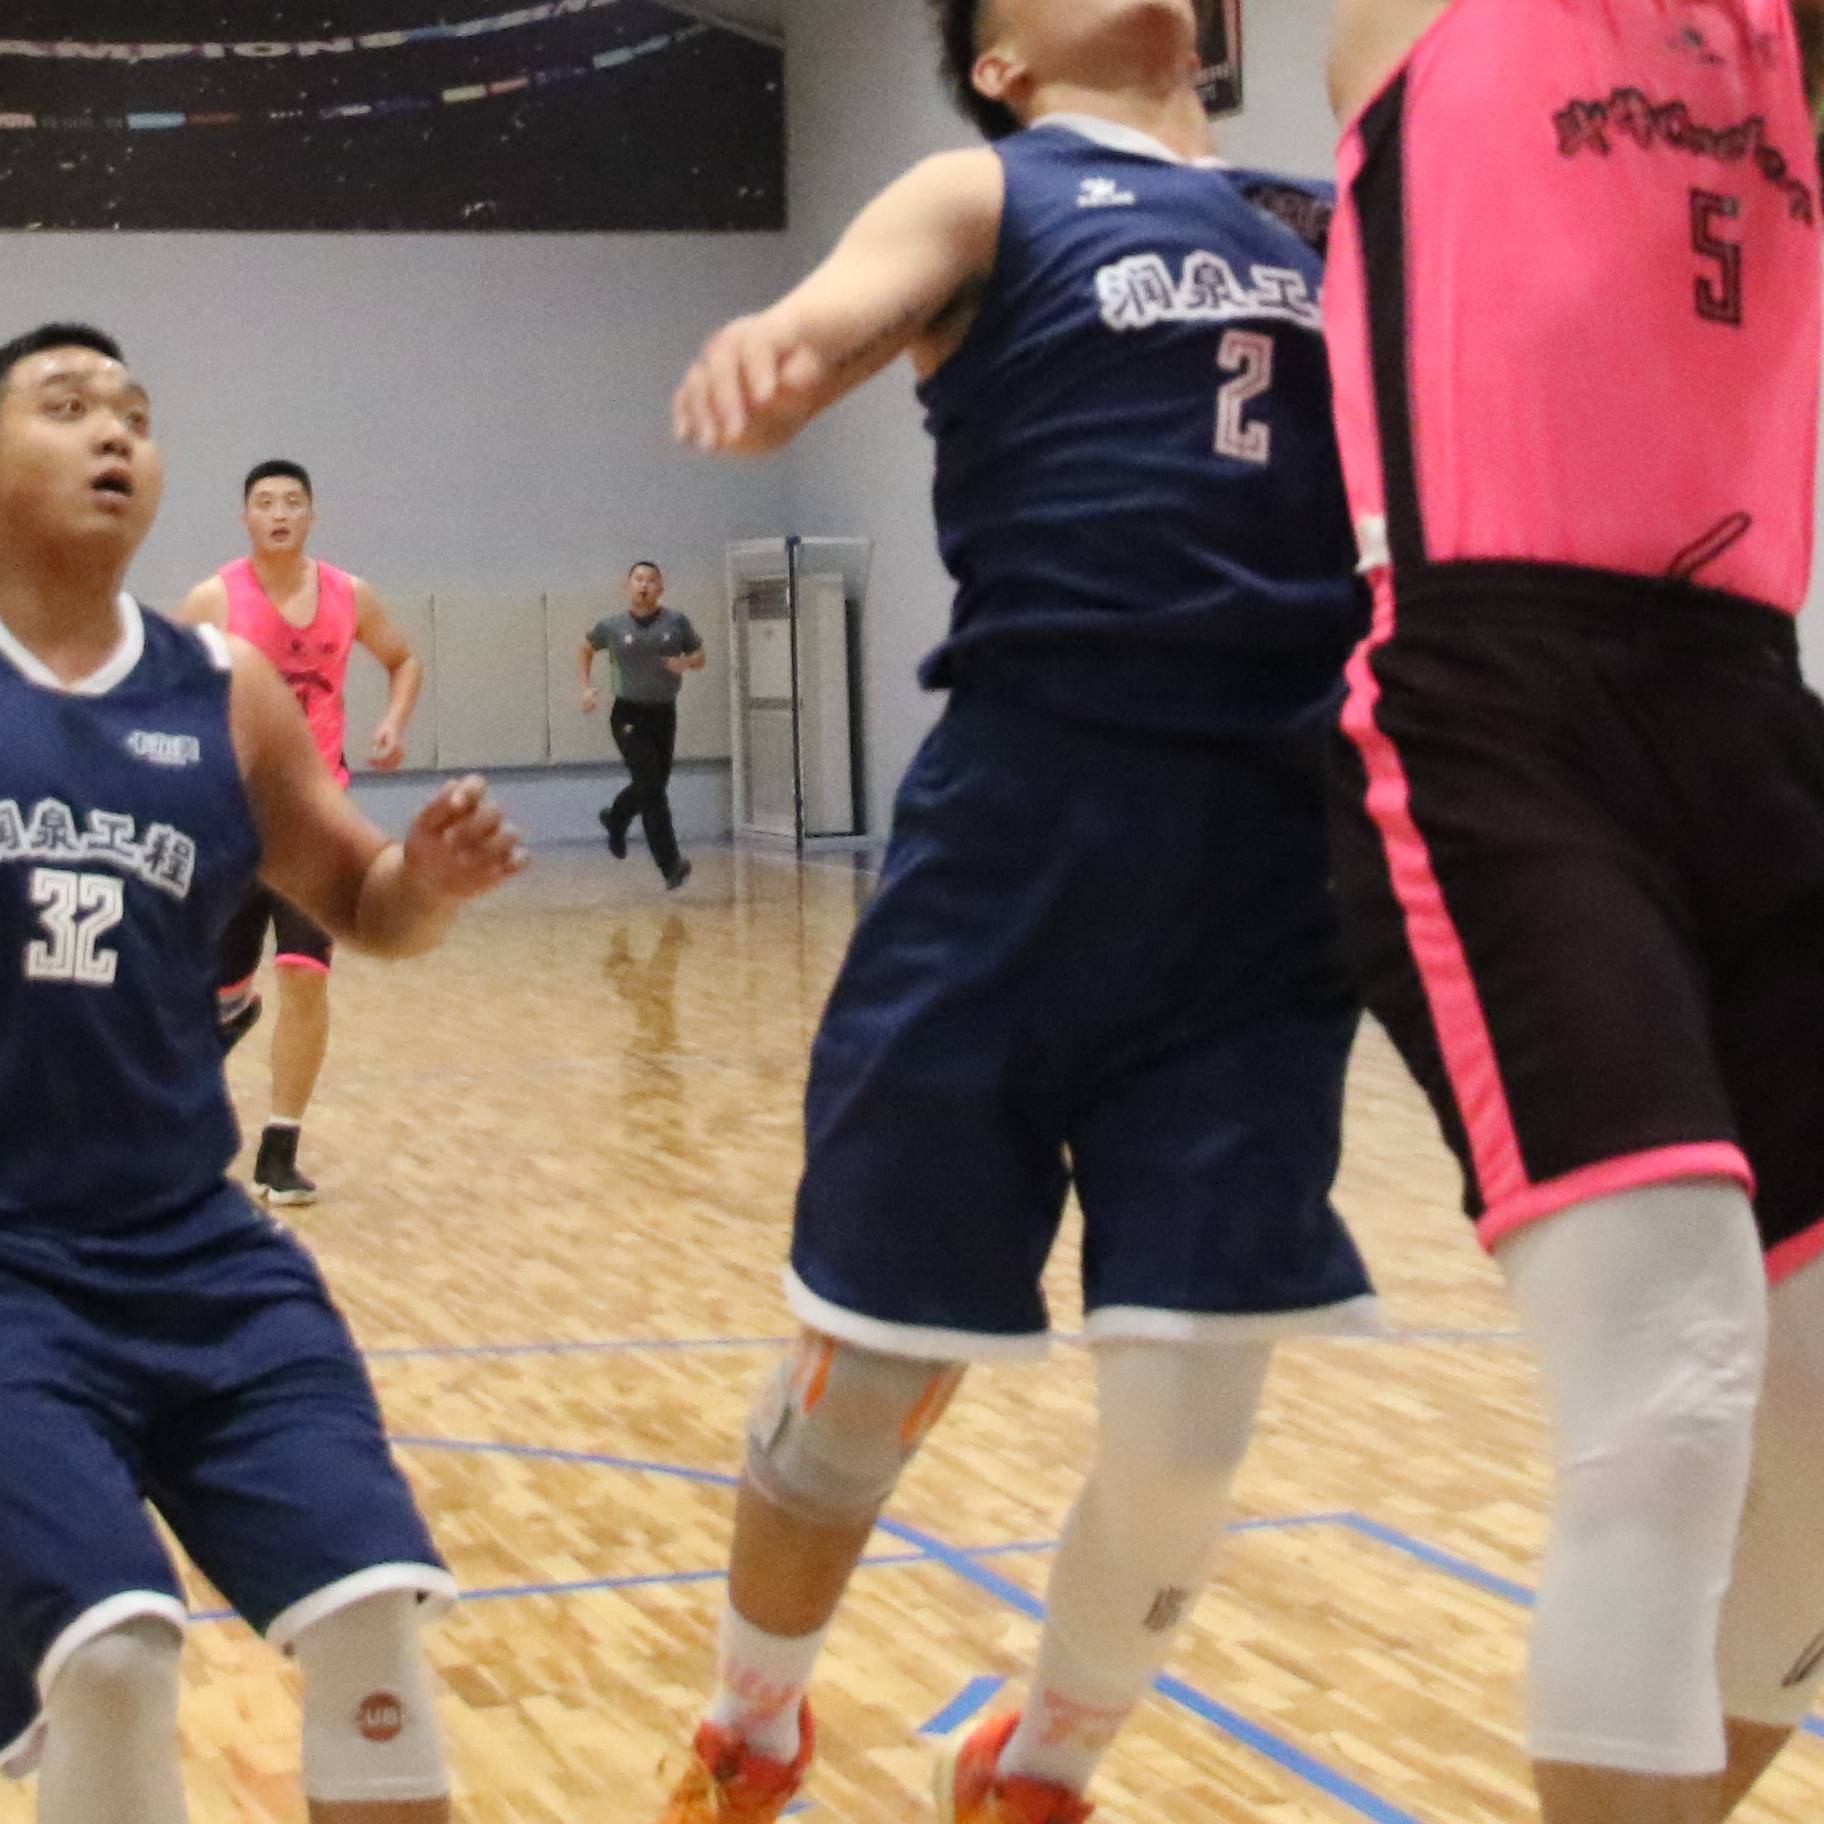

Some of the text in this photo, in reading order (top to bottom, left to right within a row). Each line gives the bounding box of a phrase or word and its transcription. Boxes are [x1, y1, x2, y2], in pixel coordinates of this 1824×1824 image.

[1094, 250, 1326, 332] 润泉工
[1688, 186, 1744, 328] 5
[1212, 328, 1274, 464] 2
[24, 866, 124, 986] 32
